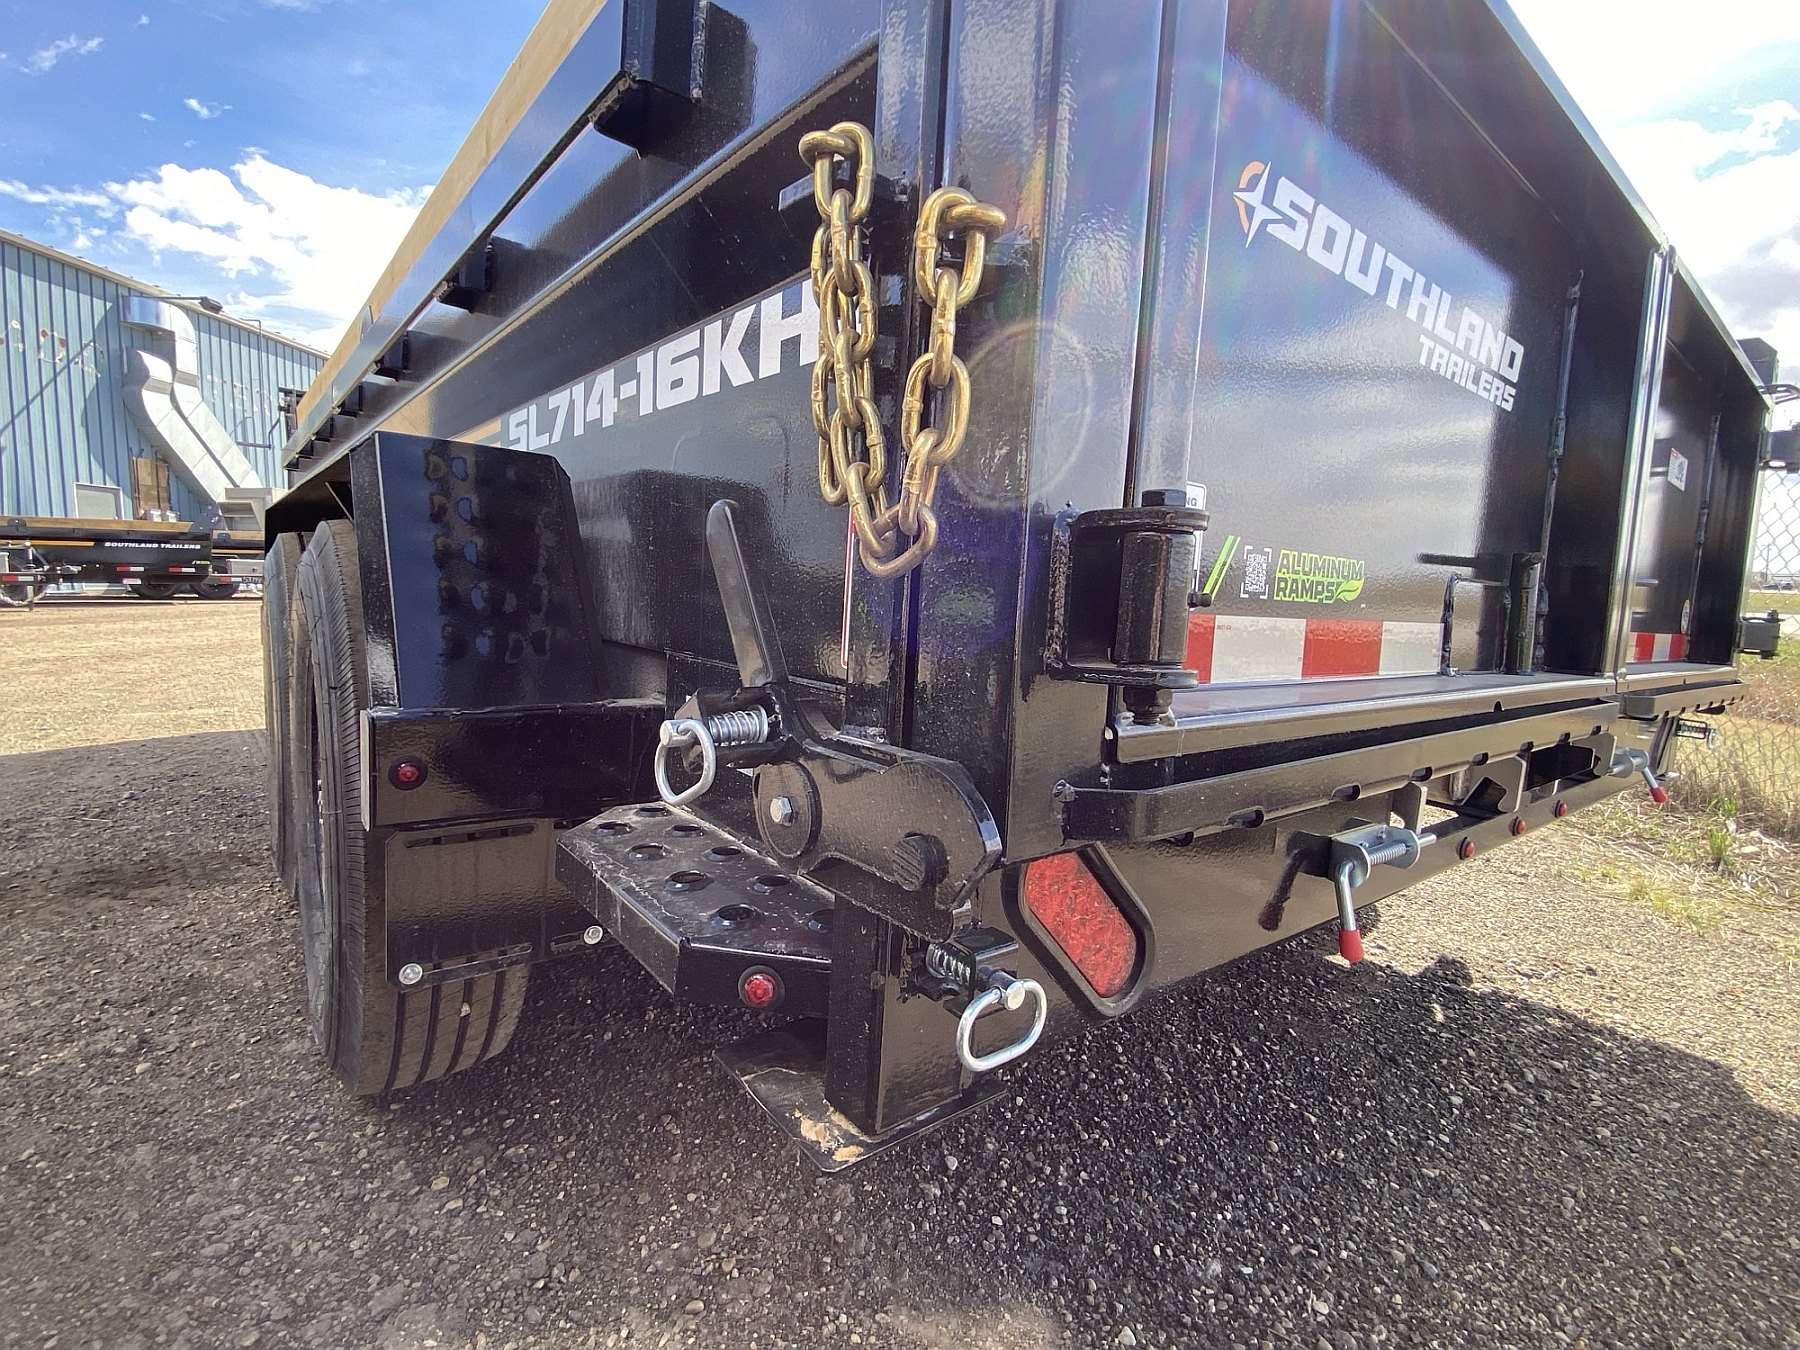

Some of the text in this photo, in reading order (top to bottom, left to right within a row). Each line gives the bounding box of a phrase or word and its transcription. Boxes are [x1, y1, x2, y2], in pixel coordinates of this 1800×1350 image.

[1266, 176, 1524, 383] SOUTHLAND
[508, 277, 862, 452] SL714-16KH
[1419, 334, 1516, 412] TRAILERS
[104, 541, 201, 550] SOUTHLAND TRAILERS
[1277, 550, 1364, 580] ALUMINUM
[1275, 576, 1337, 602] RAMPS
